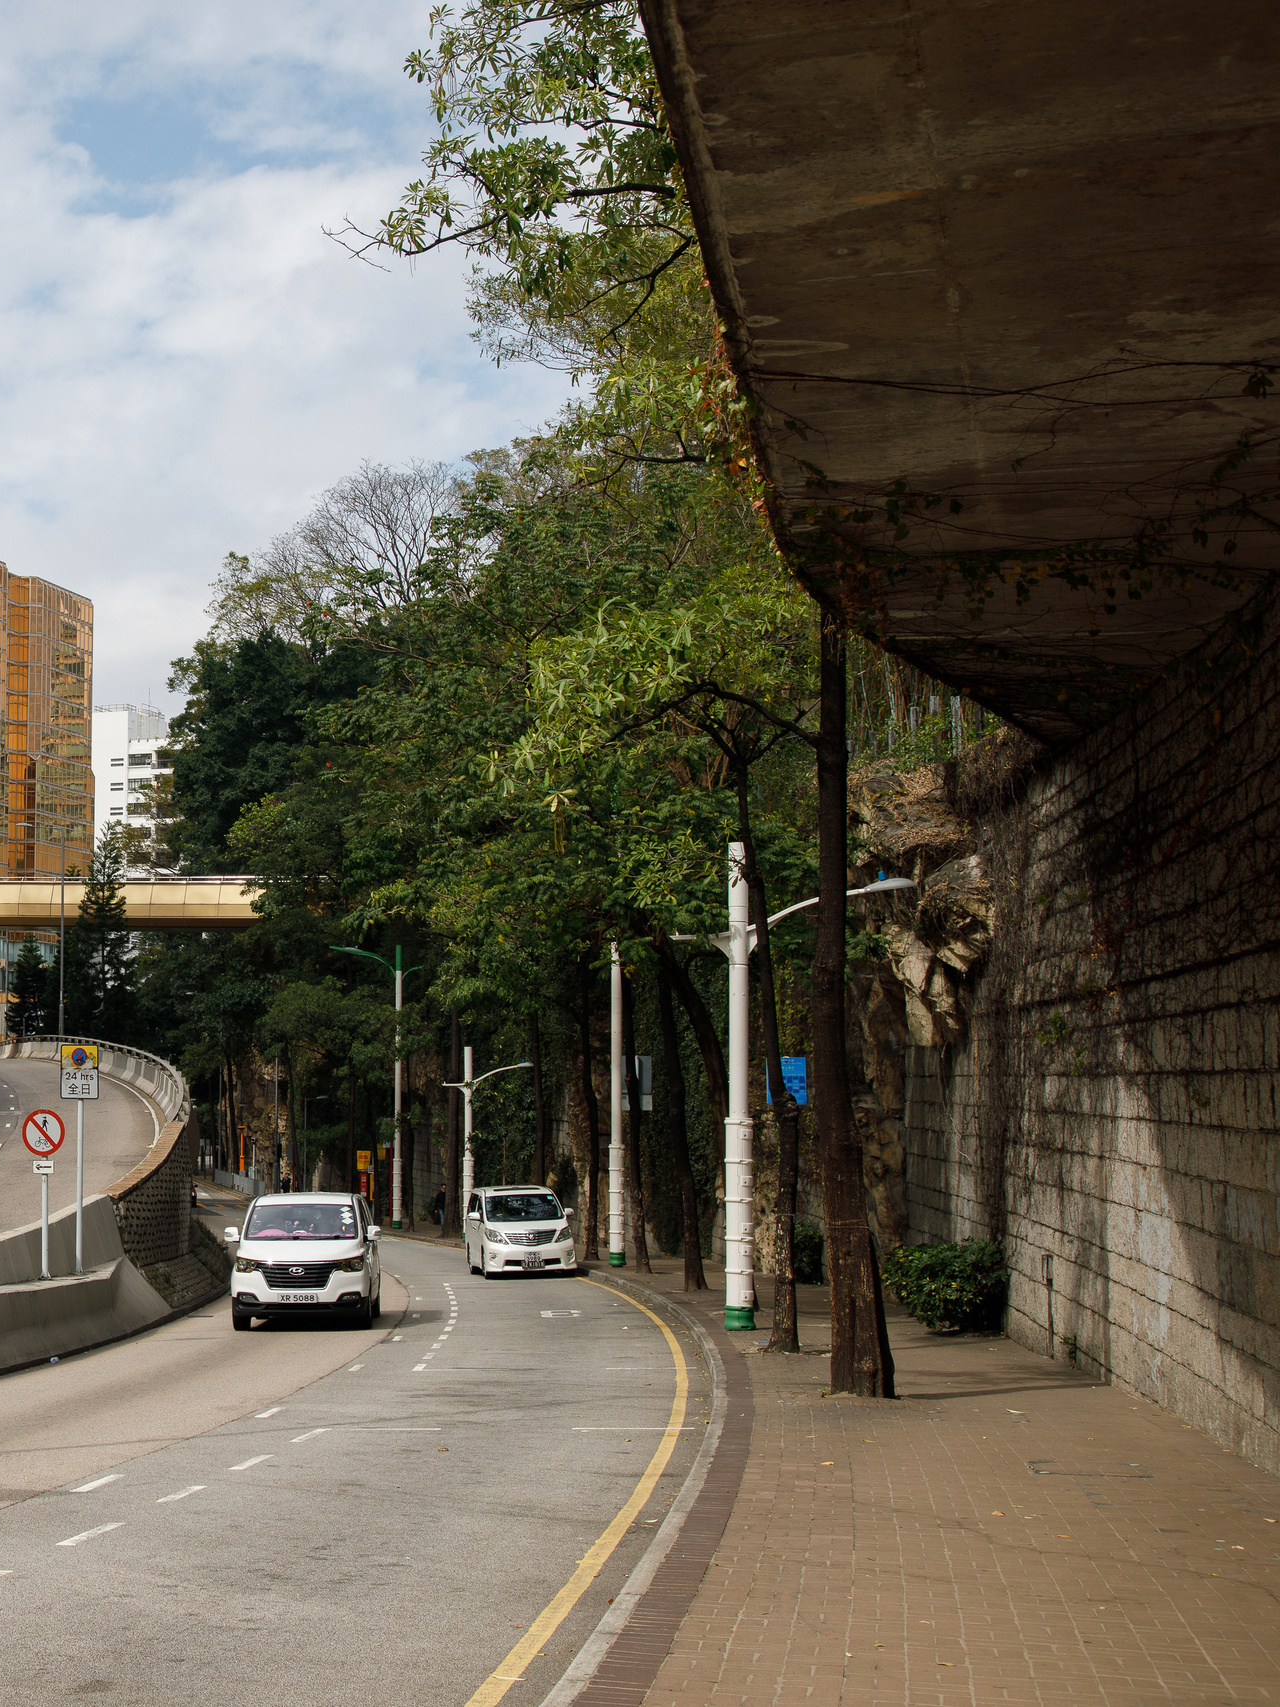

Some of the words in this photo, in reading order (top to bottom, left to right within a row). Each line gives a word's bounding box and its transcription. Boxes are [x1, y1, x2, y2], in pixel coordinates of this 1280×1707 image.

[65, 1072, 77, 1080] 24
[80, 1072, 94, 1080] hrs
[68, 1083, 90, 1095] 全日
